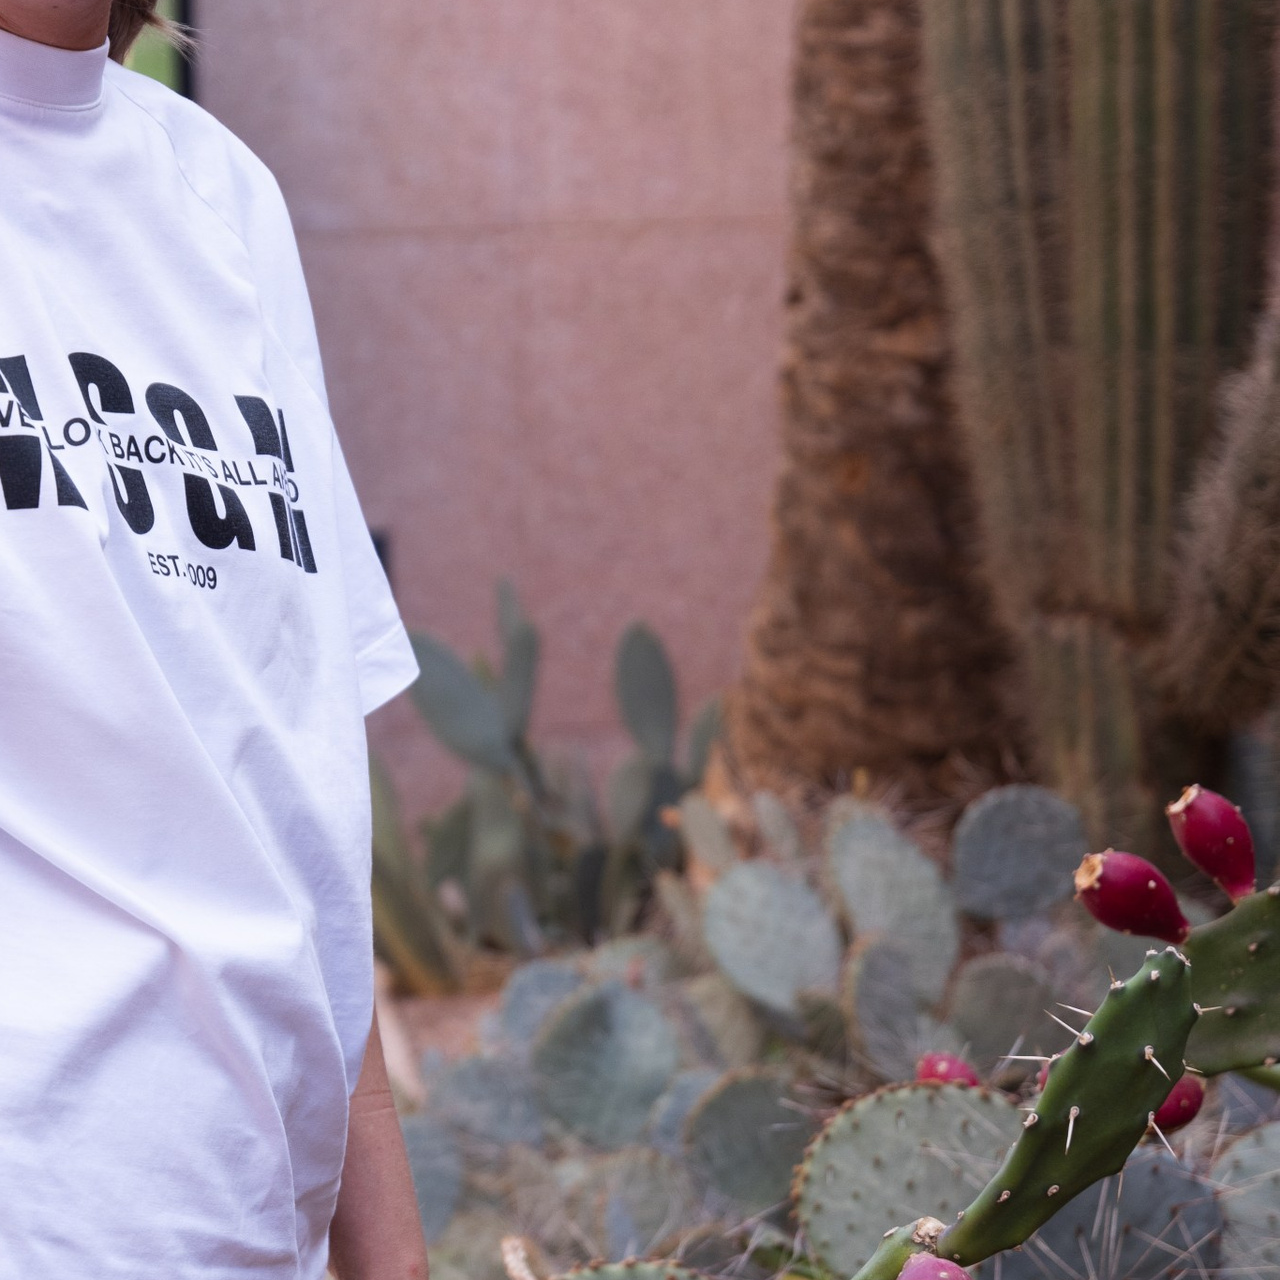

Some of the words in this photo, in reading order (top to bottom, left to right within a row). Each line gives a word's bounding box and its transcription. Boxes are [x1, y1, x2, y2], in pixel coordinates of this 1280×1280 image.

[108, 434, 185, 465] BACK
[220, 459, 268, 486] ALL
[147, 551, 187, 578] EST.
[185, 562, 218, 590] 009
